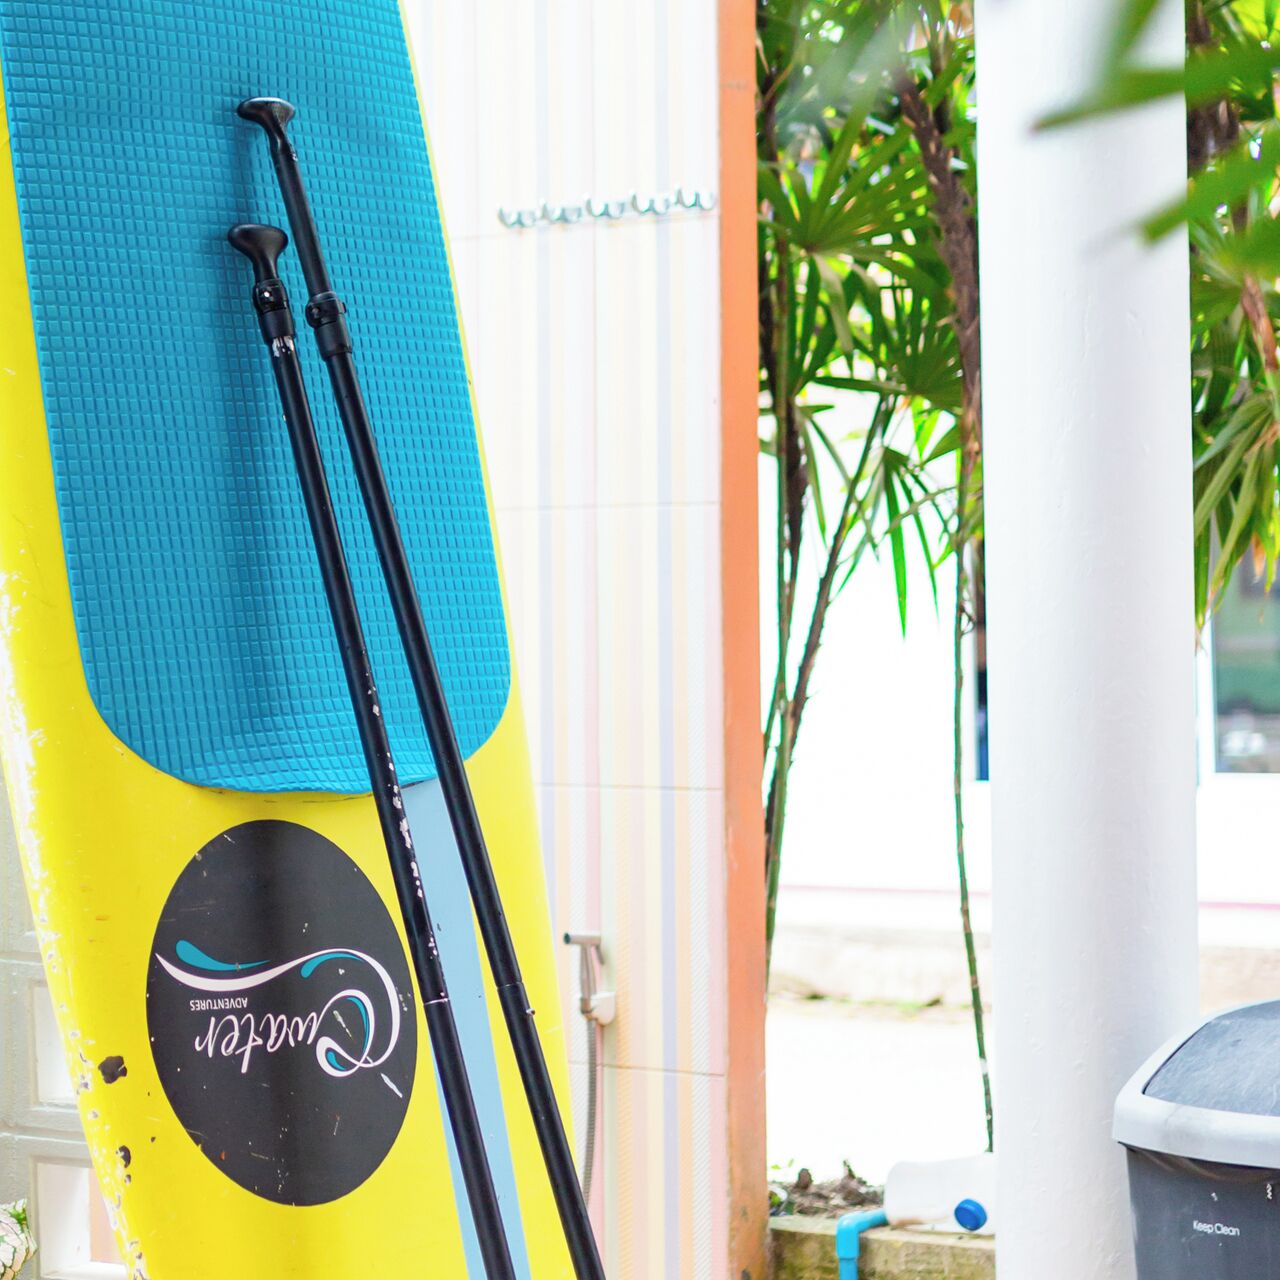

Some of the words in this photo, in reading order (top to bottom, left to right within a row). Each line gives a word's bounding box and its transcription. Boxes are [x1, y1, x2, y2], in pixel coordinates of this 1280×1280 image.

[189, 997, 248, 1011] ADVENTURES
[1193, 1220, 1213, 1234] Keep
[1214, 1223, 1240, 1236] Clean
